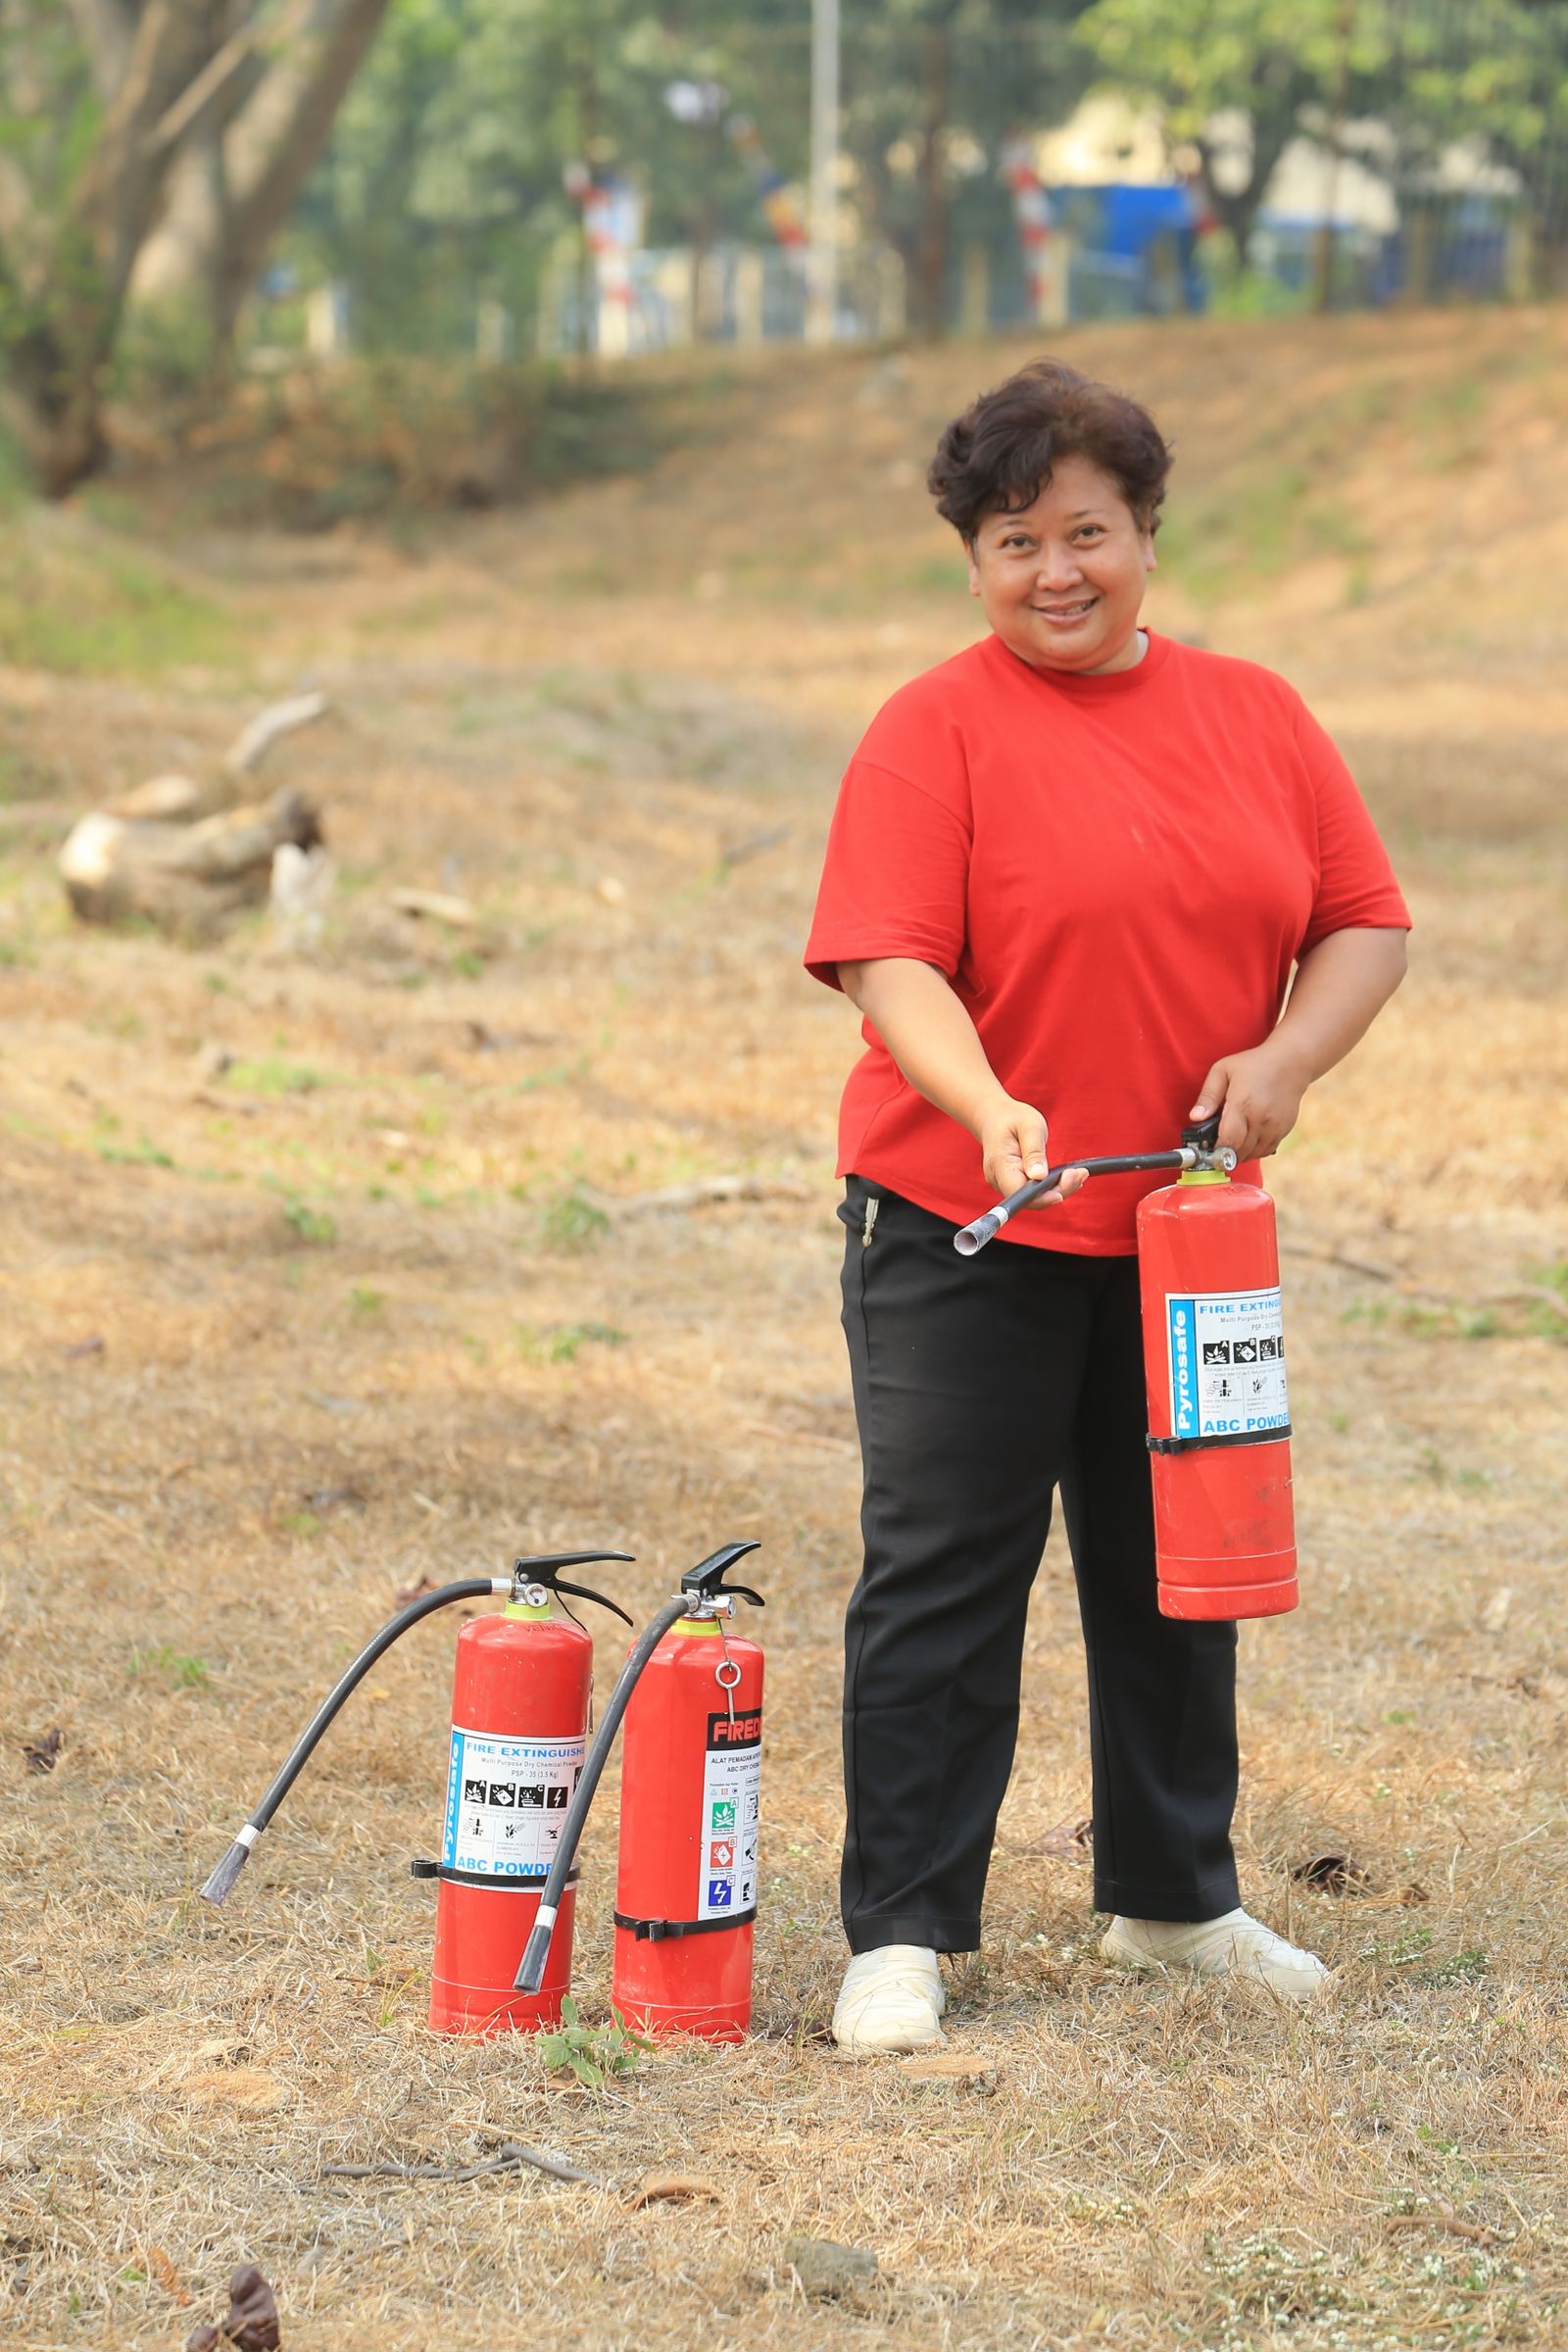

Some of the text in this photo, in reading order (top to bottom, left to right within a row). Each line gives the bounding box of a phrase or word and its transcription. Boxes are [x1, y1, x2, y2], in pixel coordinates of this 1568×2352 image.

[1200, 1304, 1235, 1314] FIRE
[1174, 1309, 1193, 1430] Pyrosafe
[1203, 1420, 1241, 1433] ABC
[466, 1741, 496, 1754] FIRE
[497, 1758, 522, 1767] Purpose
[457, 1855, 488, 1872] ABC
